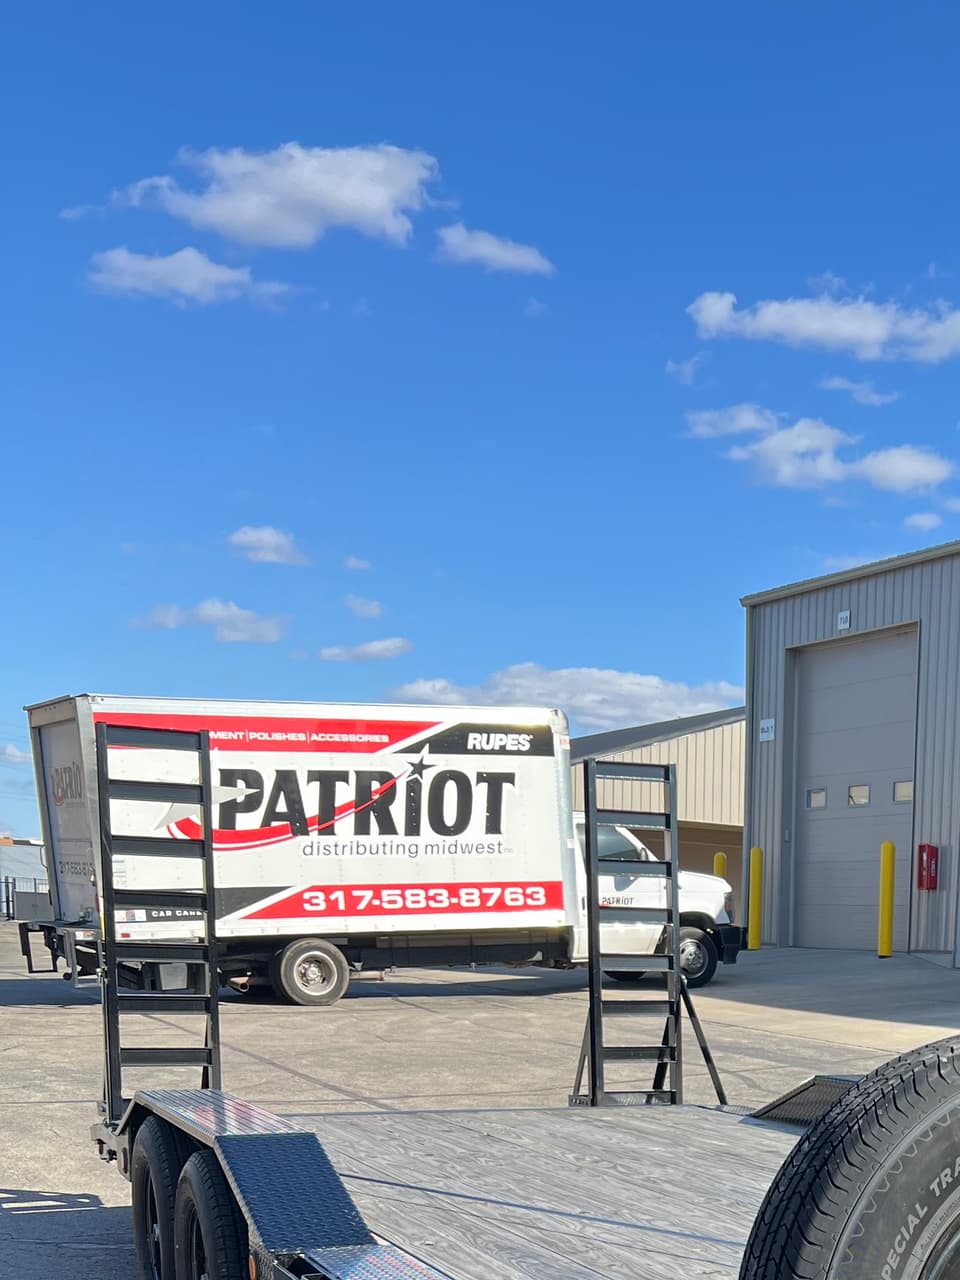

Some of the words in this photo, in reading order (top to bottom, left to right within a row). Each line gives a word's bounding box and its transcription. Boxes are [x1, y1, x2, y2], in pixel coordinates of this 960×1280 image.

[250, 731, 306, 741] POLISHES
[310, 733, 389, 743] ACCESSORIES
[467, 732, 531, 752] RUPES
[217, 766, 516, 838] PATRIOT
[302, 840, 419, 859] distributing
[424, 839, 504, 855] midwest
[302, 886, 547, 911] 317-583-8763
[151, 910, 172, 918] CAR
